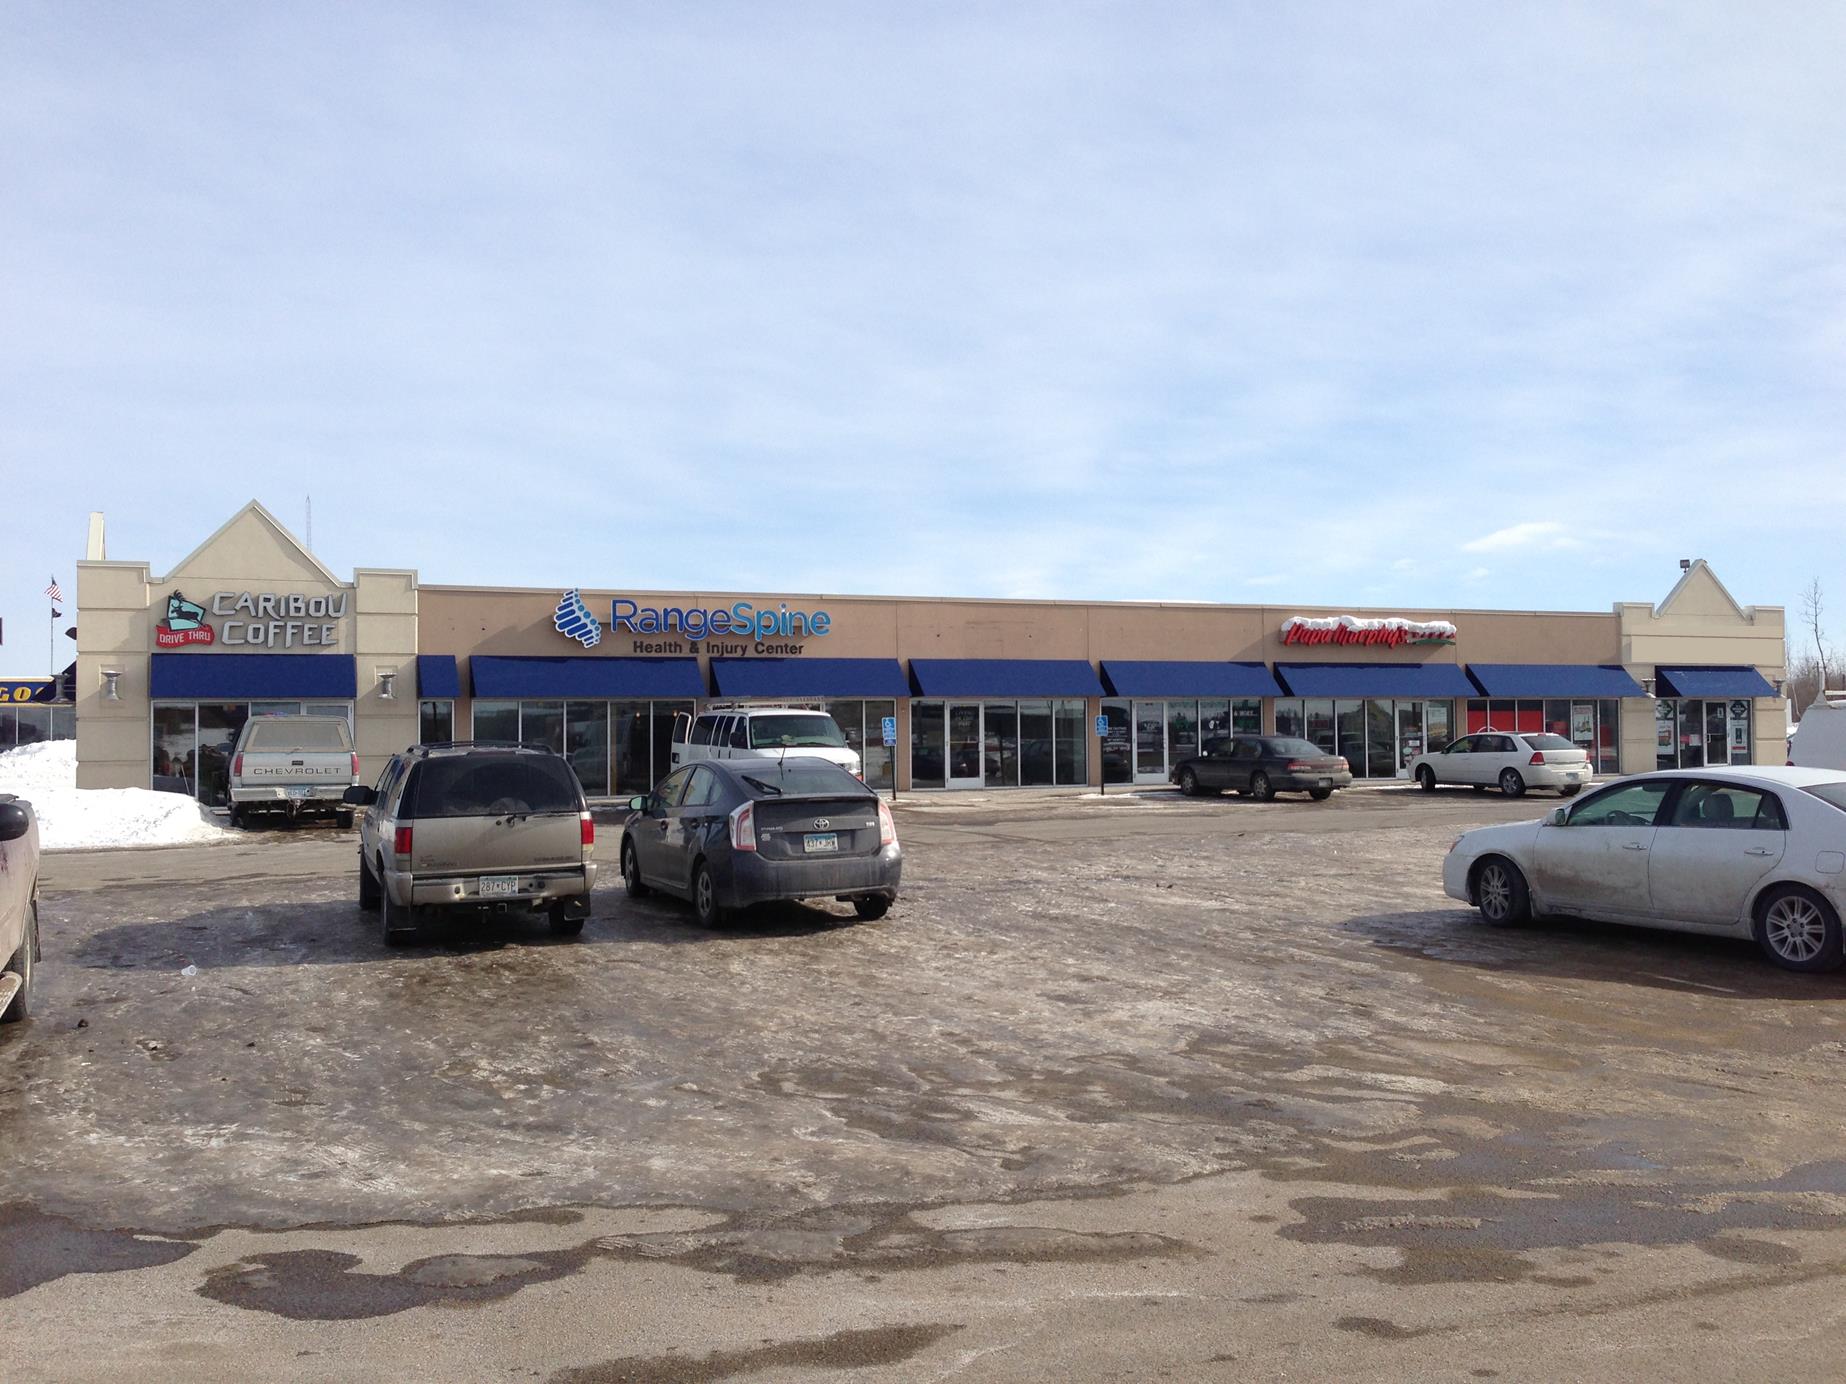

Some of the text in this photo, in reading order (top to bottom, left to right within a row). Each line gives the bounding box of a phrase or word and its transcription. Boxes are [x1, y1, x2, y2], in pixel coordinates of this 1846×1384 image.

[211, 591, 347, 620] CARIBOU
[610, 599, 831, 641] RangeSpine
[159, 631, 211, 643] DRIVE THRU
[221, 621, 338, 648] COFFEE
[633, 641, 804, 656] Health & Injury Center
[253, 767, 341, 775] CHEVROLET
